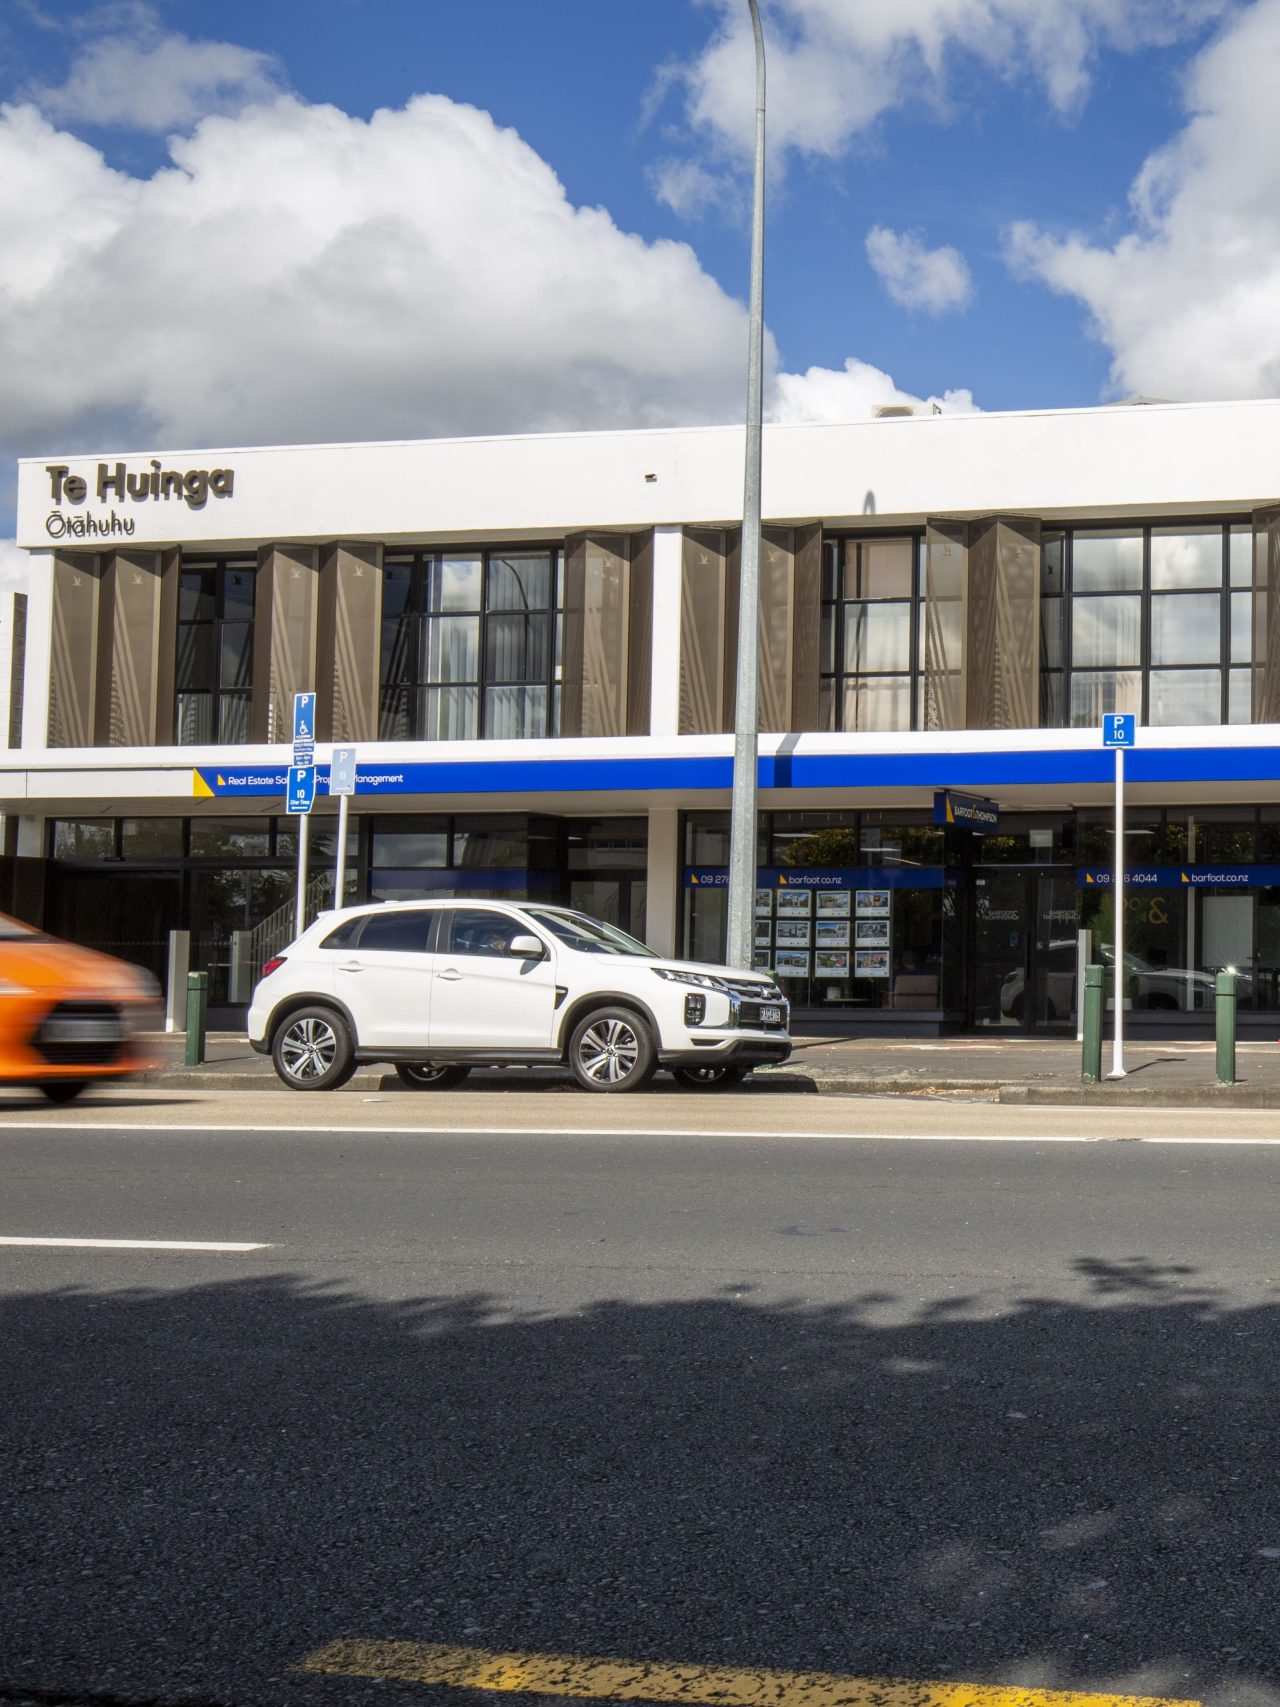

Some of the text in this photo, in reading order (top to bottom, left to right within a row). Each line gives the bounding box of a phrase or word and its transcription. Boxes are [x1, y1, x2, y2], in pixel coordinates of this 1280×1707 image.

[46, 460, 234, 509] Te Huinga
[46, 510, 134, 538] Ōtāhuhu
[301, 695, 309, 708] P
[1113, 716, 1125, 729] P
[1114, 729, 1125, 740] 10
[340, 751, 348, 763] P
[228, 776, 247, 786] Real
[247, 775, 274, 785] Estate
[355, 774, 403, 786] anagement
[297, 769, 307, 782] P
[339, 771, 347, 780] 10
[296, 789, 305, 799] 10
[700, 874, 714, 884] 09
[1096, 873, 1110, 883] 09
[1132, 873, 1158, 883] 4044
[1191, 873, 1249, 883] barfoot.co.nz
